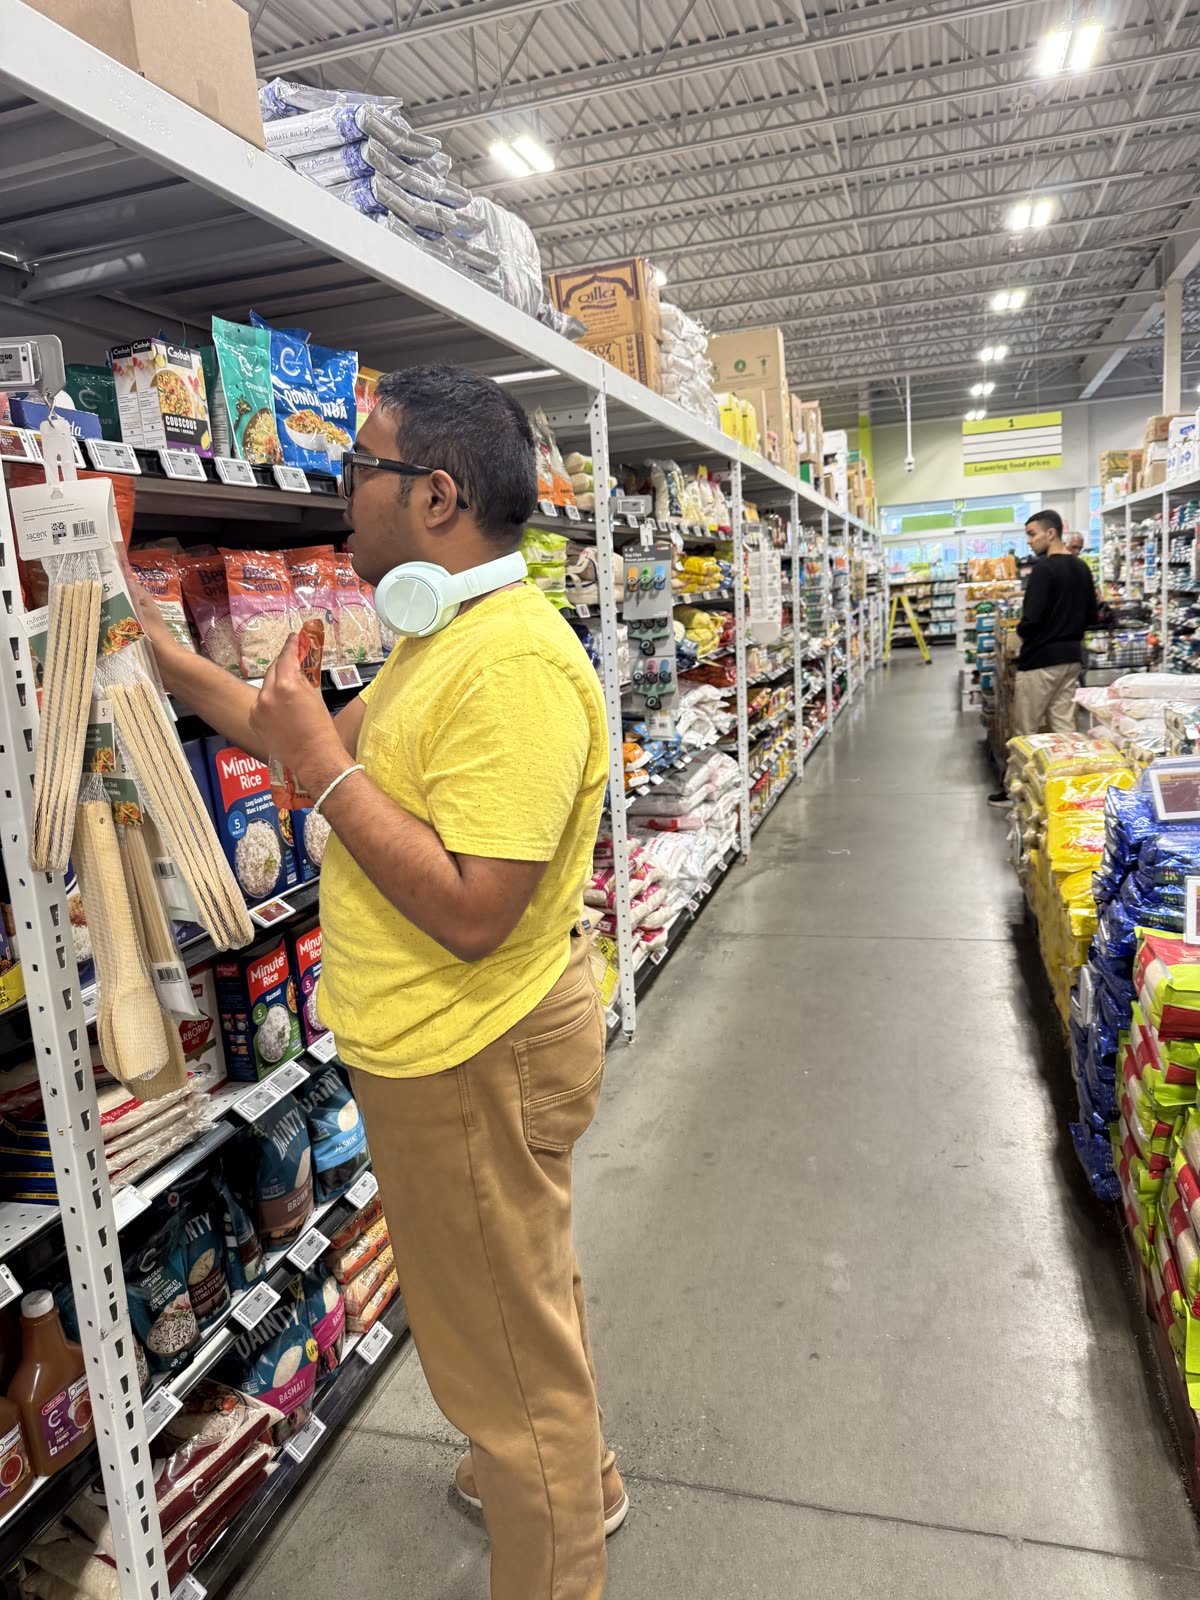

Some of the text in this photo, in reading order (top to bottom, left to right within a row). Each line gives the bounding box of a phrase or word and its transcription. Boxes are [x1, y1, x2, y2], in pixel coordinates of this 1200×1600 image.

[113, 347, 131, 356] Casbah
[132, 341, 151, 350] Casbah
[167, 347, 191, 360] Casbah
[165, 415, 198, 431] COUSCOUS
[1008, 419, 1014, 428] 1
[974, 459, 1051, 473] Lowering food prices
[104, 582, 110, 593] 5
[243, 580, 283, 594] Original
[26, 612, 49, 626] culinar
[240, 773, 262, 790] Rice
[234, 818, 241, 829] 5
[251, 956, 285, 983] Minute
[262, 972, 279, 987] Rice
[306, 980, 310, 988] 5
[257, 1009, 263, 1018] 5
[287, 1189, 309, 1213] BROWN
[279, 1379, 306, 1404] BASMATI
